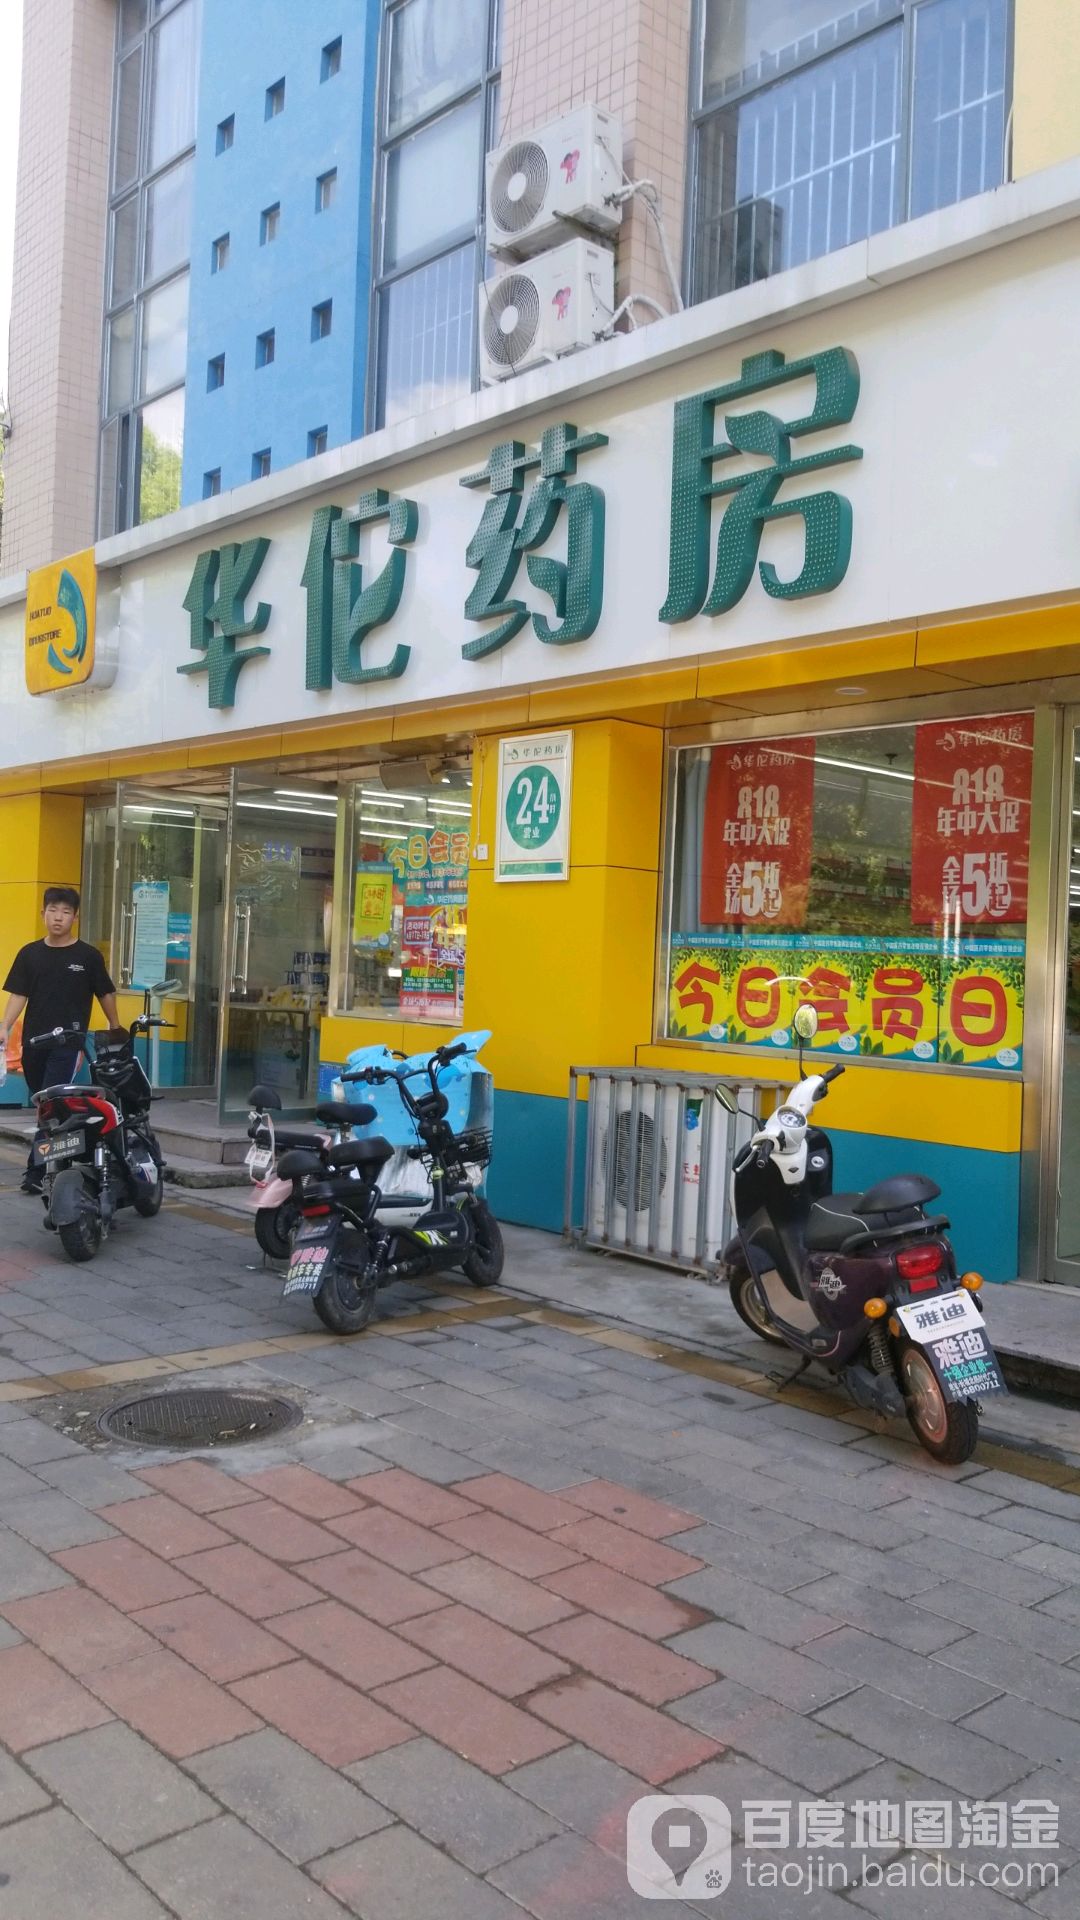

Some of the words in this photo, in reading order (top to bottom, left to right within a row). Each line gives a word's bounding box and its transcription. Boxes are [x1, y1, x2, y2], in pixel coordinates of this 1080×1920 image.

[177, 346, 863, 708] 华佗药房
[958, 727, 1023, 747] 华佗药房
[743, 753, 795, 768] 华佗药房
[516, 775, 549, 825] 24
[737, 784, 780, 818] 818
[953, 764, 1004, 805] 818
[523, 827, 540, 839] 营业
[723, 818, 791, 846] 年中大促
[937, 802, 1020, 837] 年中大促
[915, 1303, 967, 1329] 雅迪
[932, 1331, 988, 1369] 雅迪
